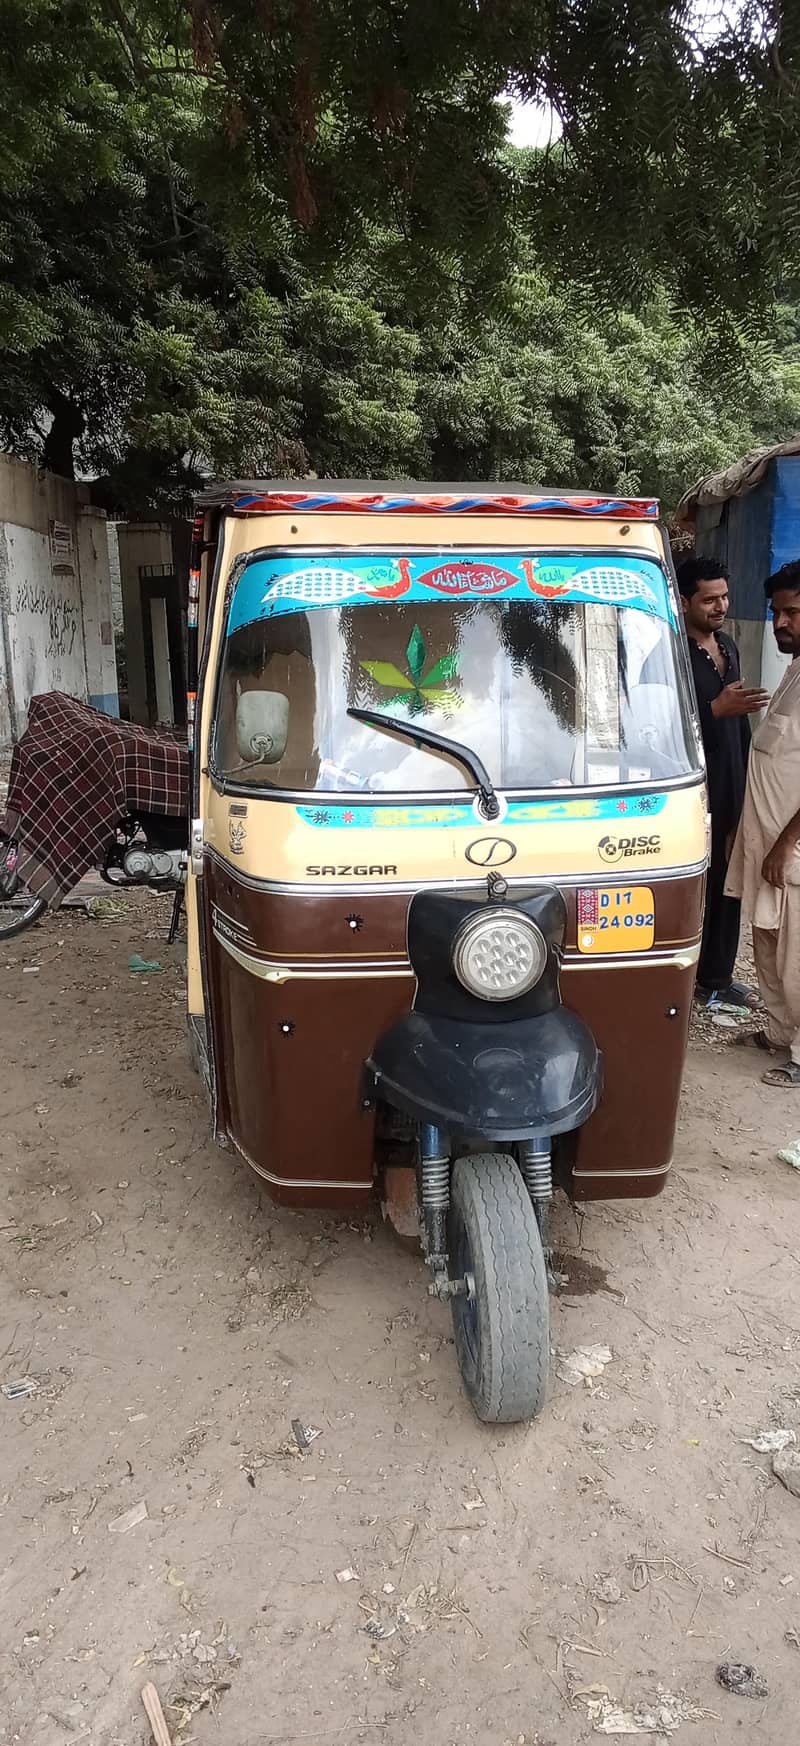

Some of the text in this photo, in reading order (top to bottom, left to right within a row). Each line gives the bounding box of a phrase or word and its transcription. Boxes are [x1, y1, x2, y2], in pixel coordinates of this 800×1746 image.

[618, 834, 661, 850] DISC
[624, 846, 661, 857] Brake
[305, 864, 398, 877] SAZGAR
[599, 914, 654, 929] 24092
